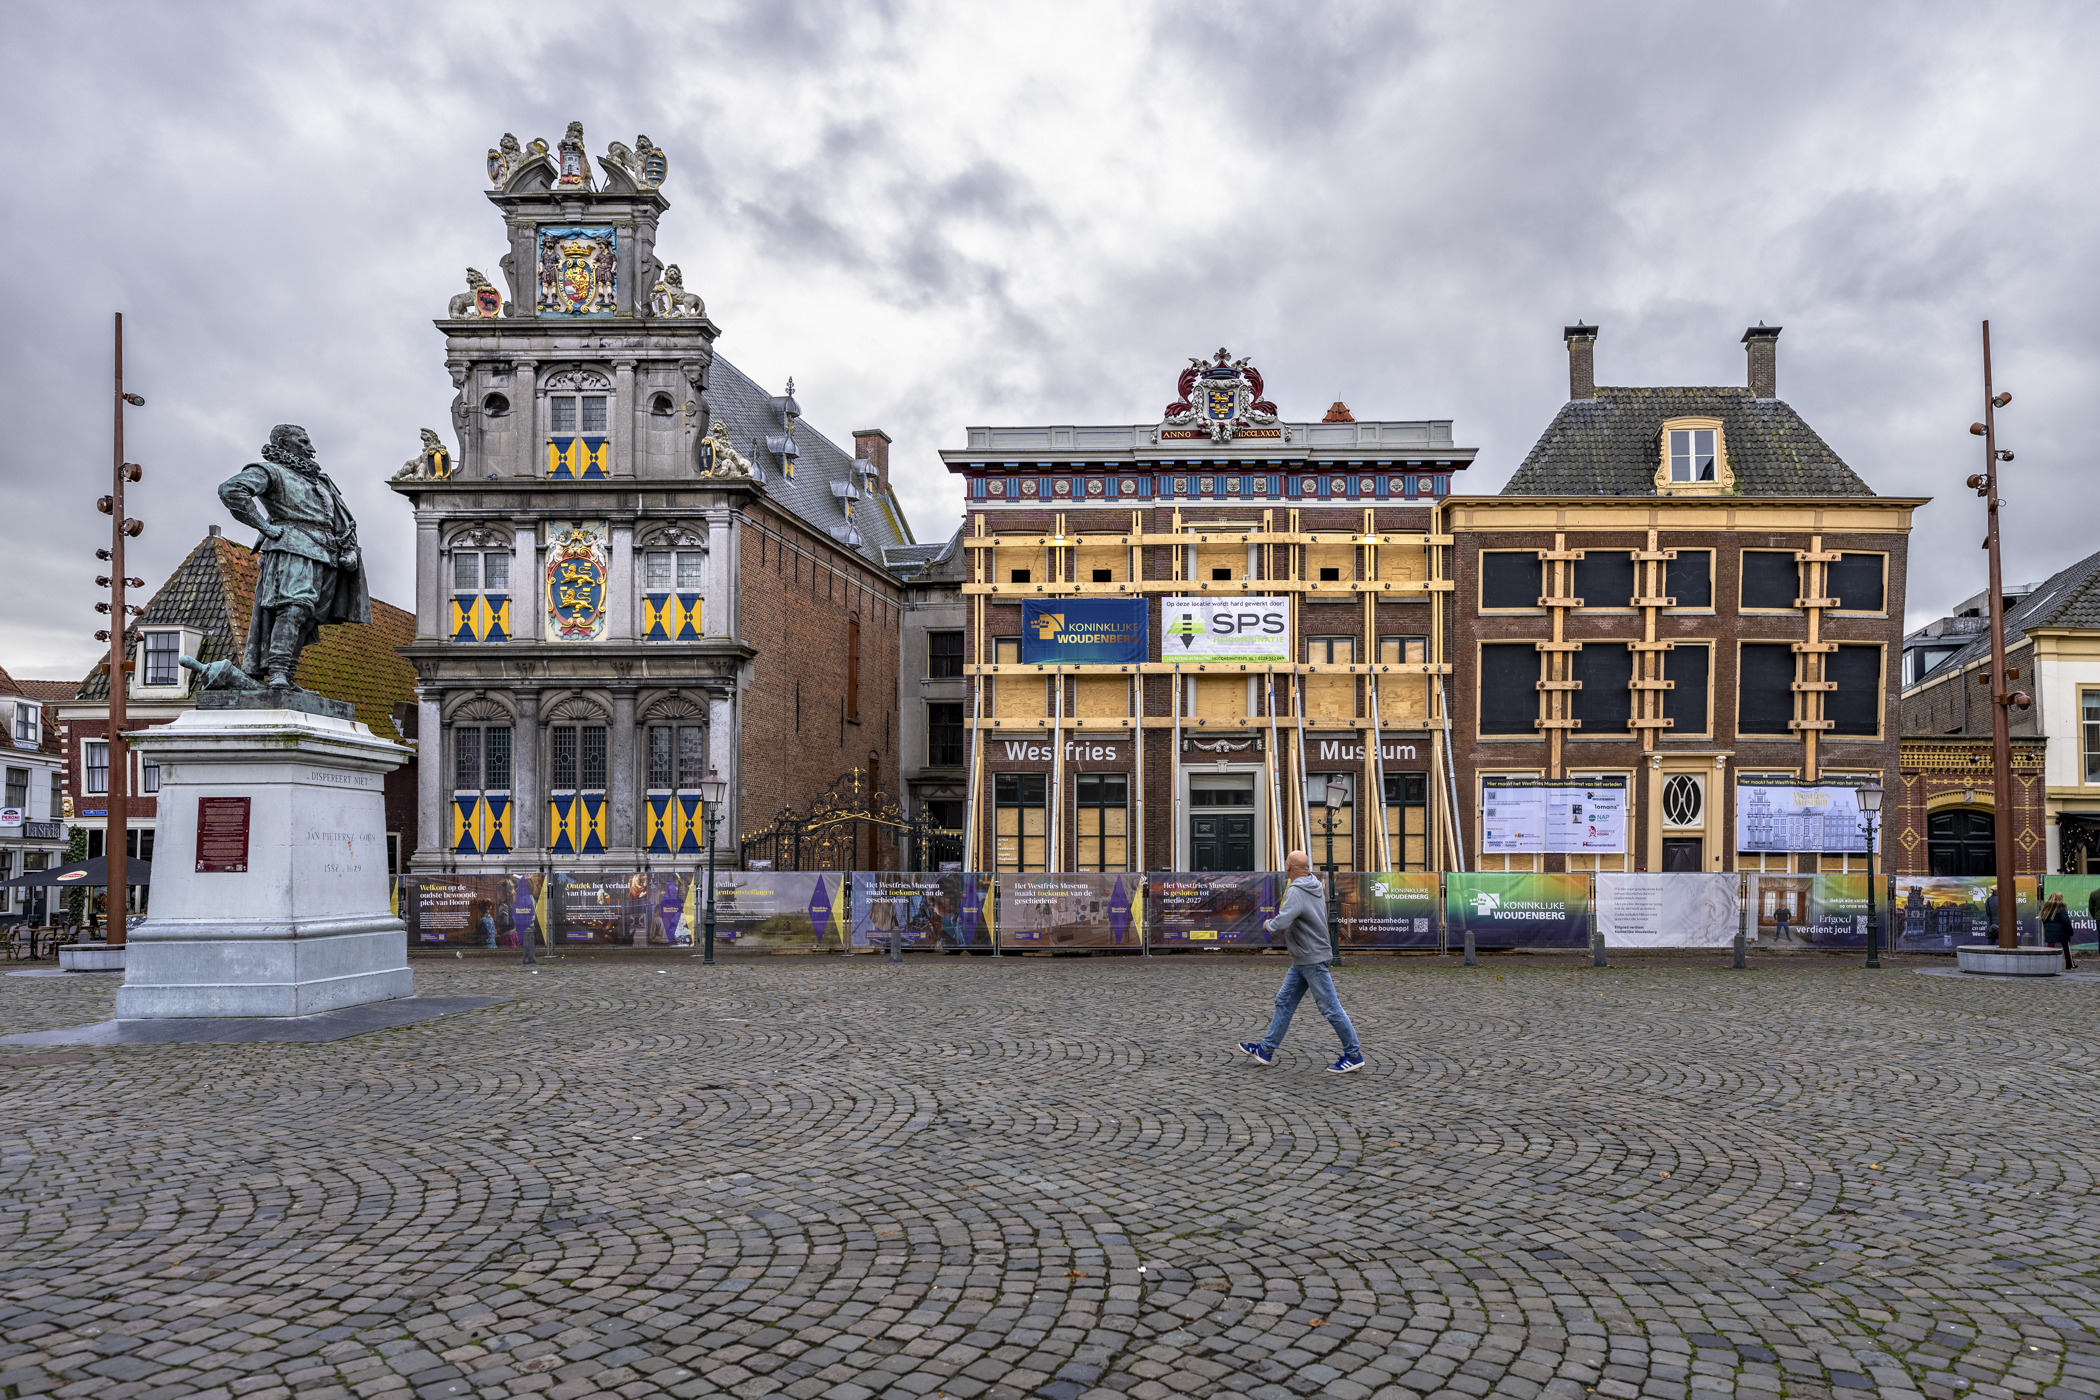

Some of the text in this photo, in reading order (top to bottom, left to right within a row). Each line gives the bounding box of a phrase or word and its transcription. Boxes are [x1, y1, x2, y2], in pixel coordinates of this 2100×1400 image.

[1068, 624, 1139, 632] KONINKLIJKE
[1212, 613, 1284, 634] SPS
[1057, 634, 1140, 643] WOUDENBERG
[1004, 741, 1416, 760] Wesfries Musum
[26, 822, 60, 838] La Sfida
[306, 832, 320, 840] JAN
[324, 864, 339, 873] 1587
[1820, 915, 1852, 924] Erfgoed
[1796, 925, 1851, 935] verdient jou!
[2071, 920, 2097, 931] inklij
